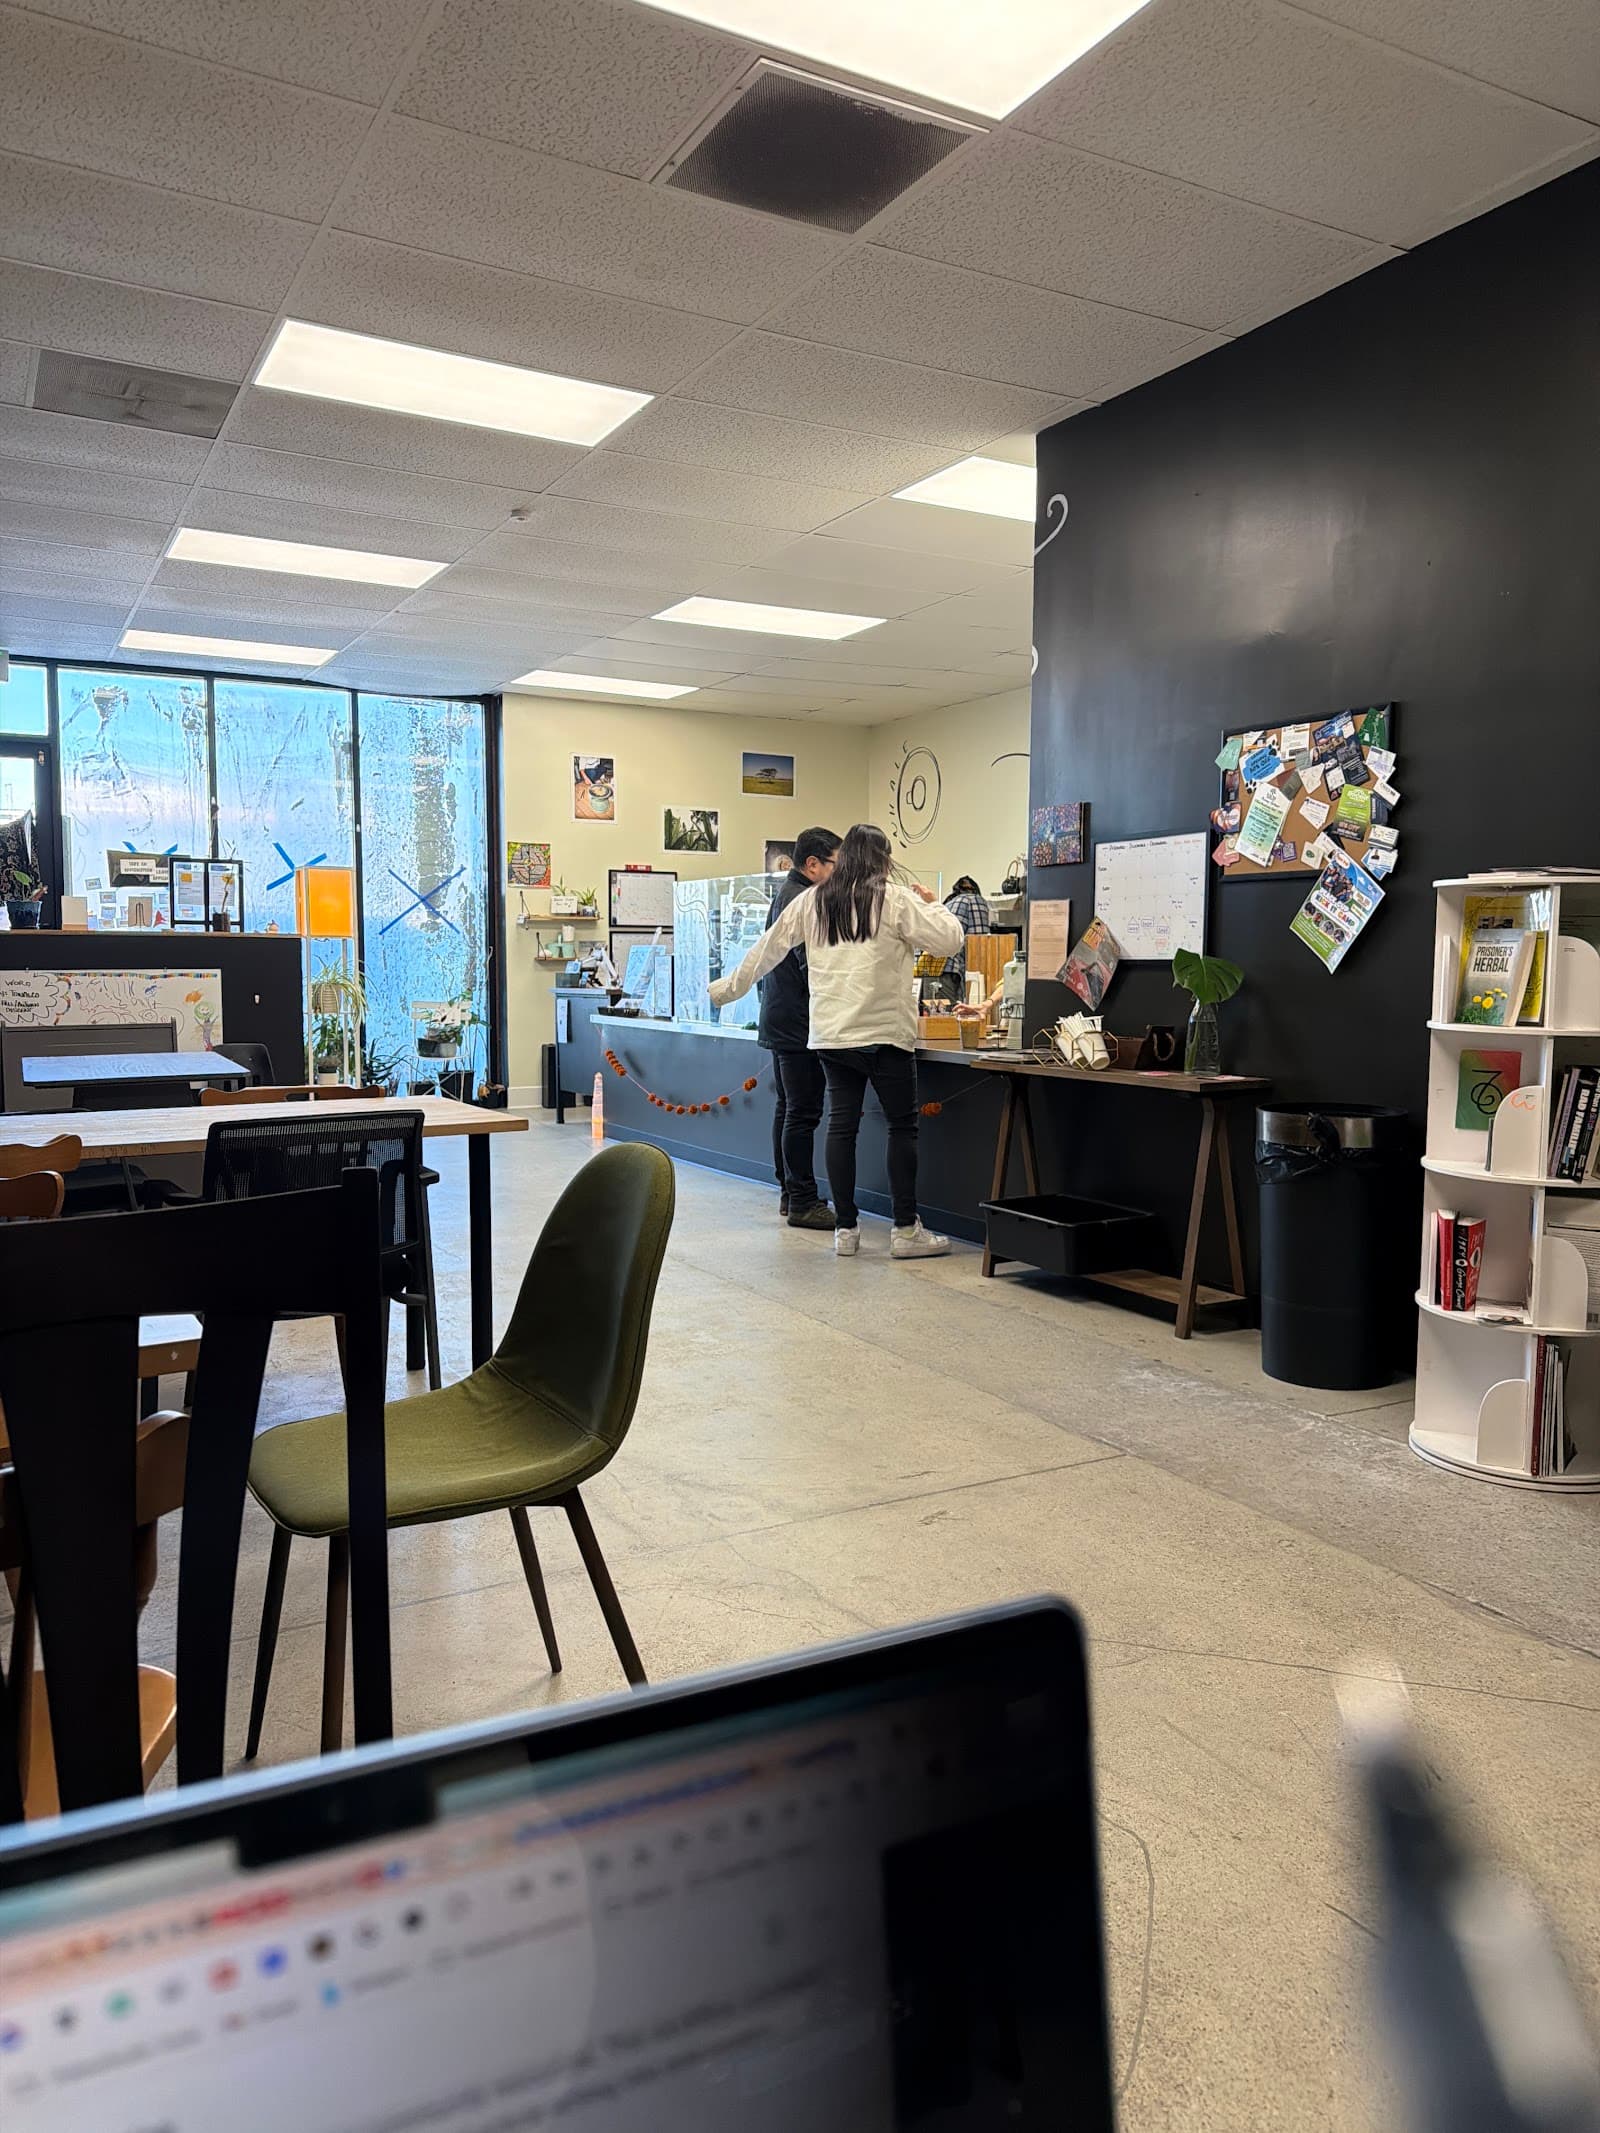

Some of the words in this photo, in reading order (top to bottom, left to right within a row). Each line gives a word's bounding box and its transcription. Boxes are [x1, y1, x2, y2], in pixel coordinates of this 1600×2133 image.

[1314, 893, 1330, 908] KICK
[1337, 910, 1356, 927] CAMP
[1476, 946, 1514, 957] PRISONER'S
[1473, 957, 1509, 973] HERBAL
[1578, 1088, 1590, 1110] RAD
